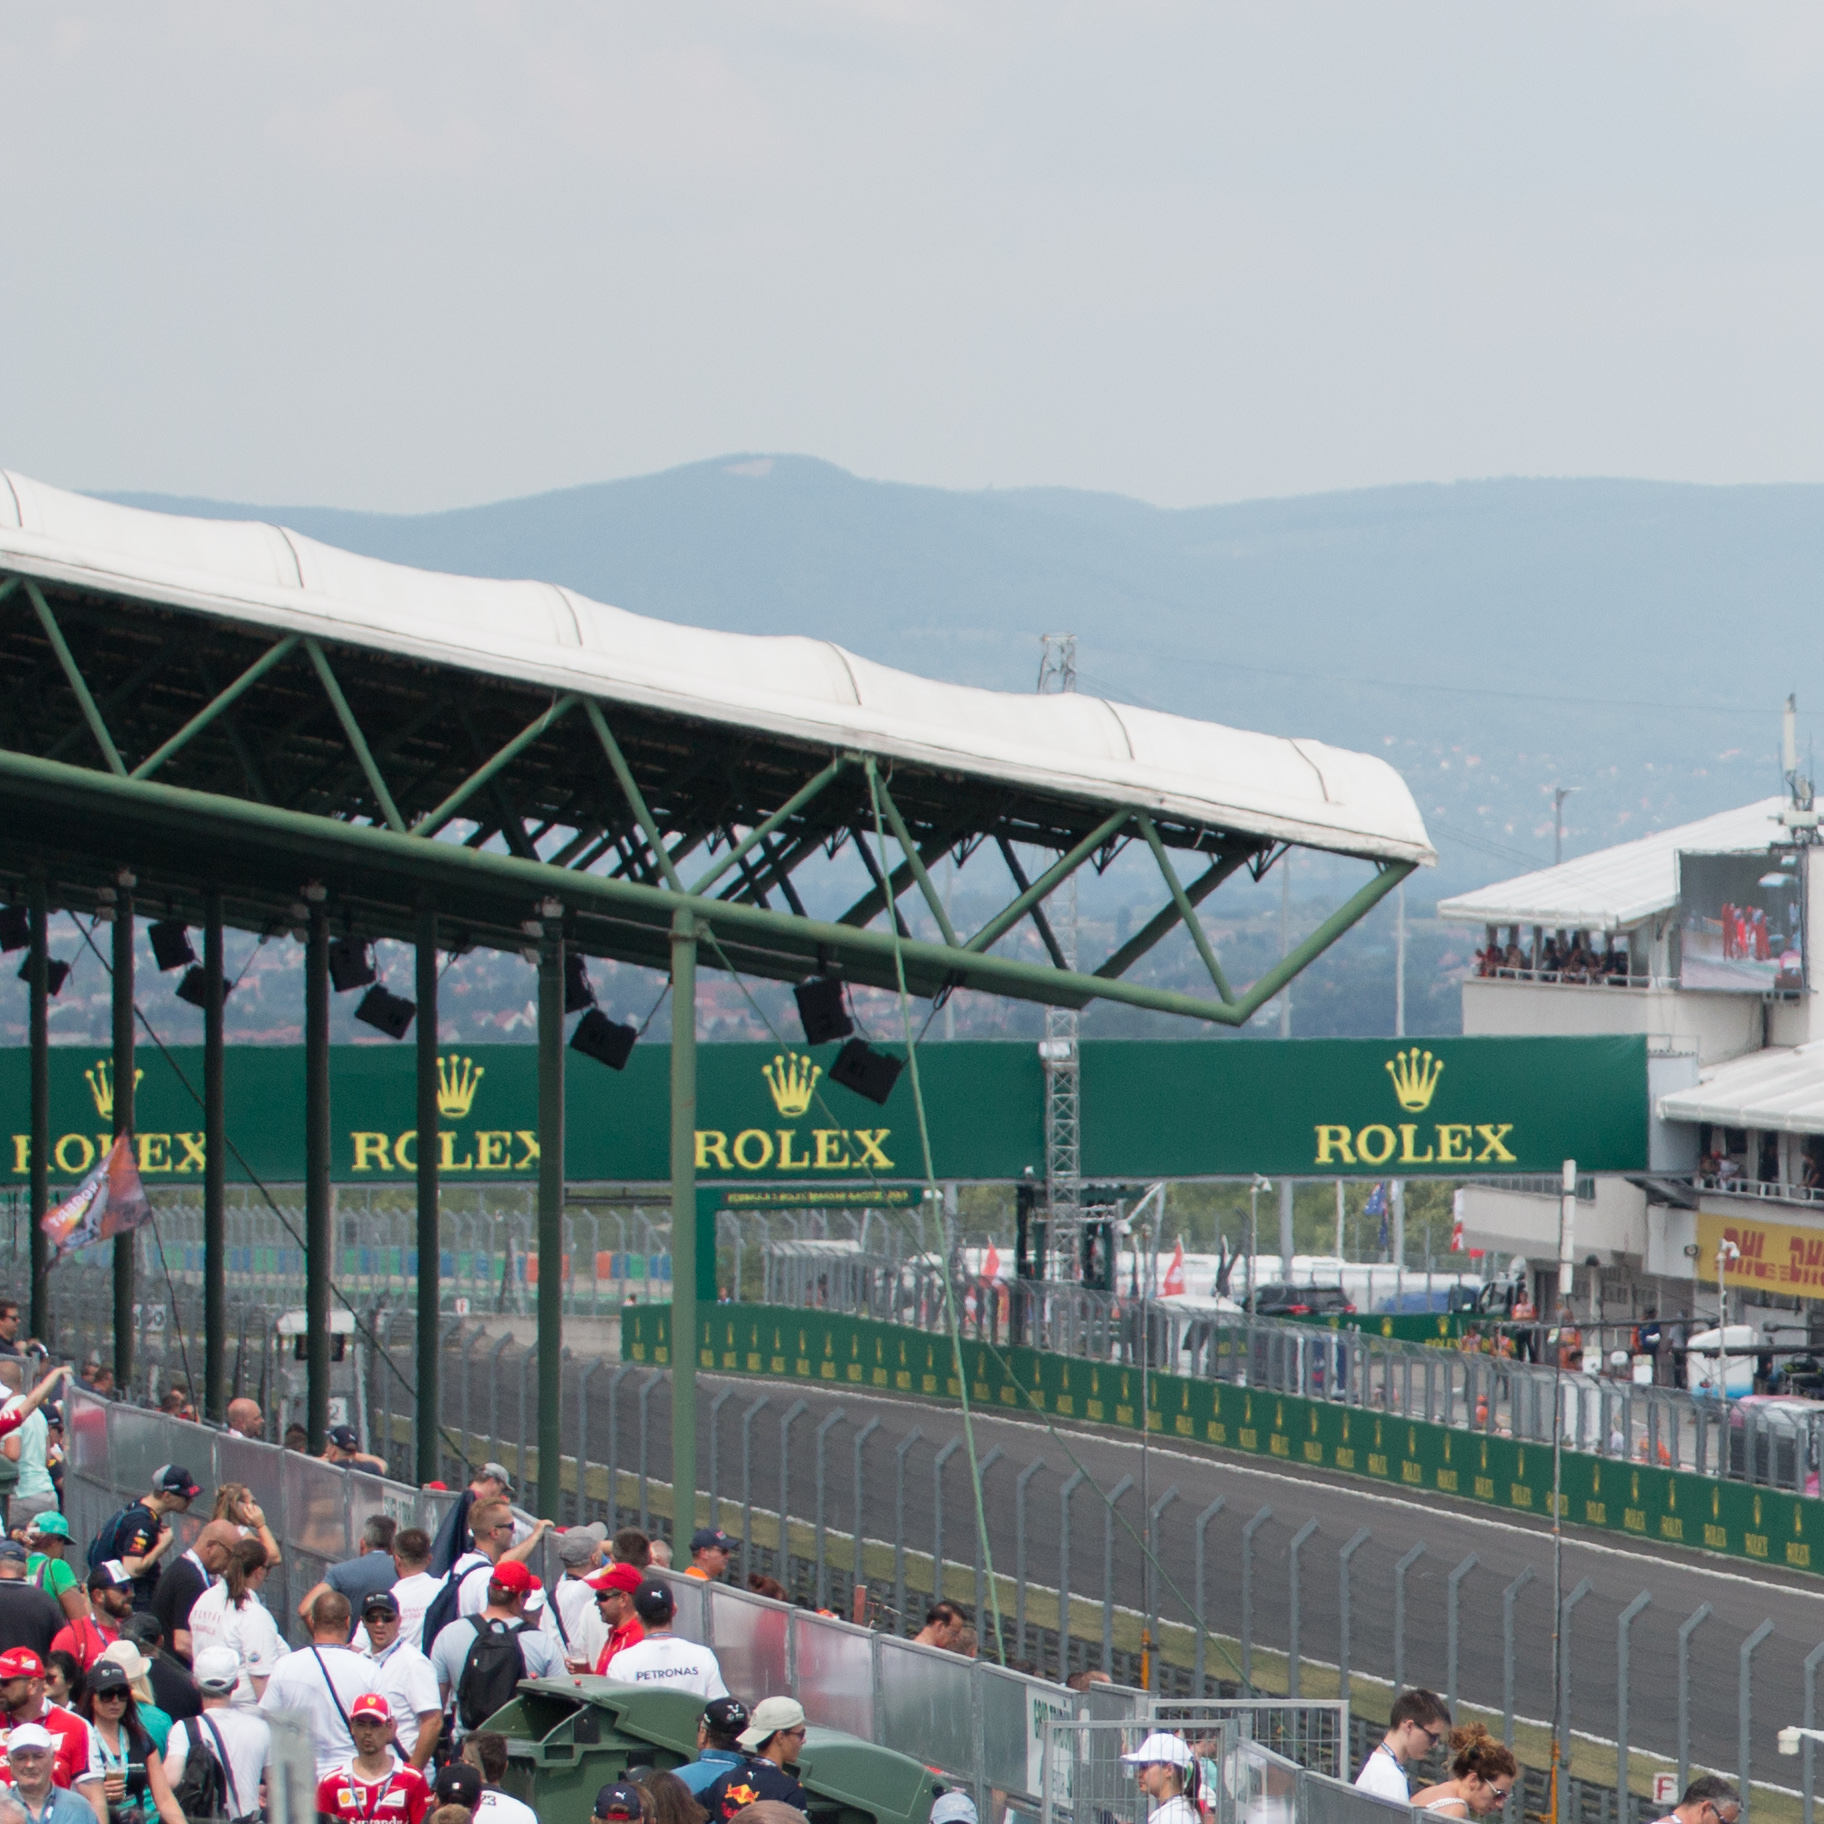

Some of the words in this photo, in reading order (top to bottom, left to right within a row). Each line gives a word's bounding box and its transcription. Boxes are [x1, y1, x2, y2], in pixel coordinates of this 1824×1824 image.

[693, 1128, 895, 1171] ROLEX
[1314, 1123, 1517, 1165] ROLEX
[635, 1666, 699, 1681] PETRONAS
[1656, 1775, 1674, 1801] F
